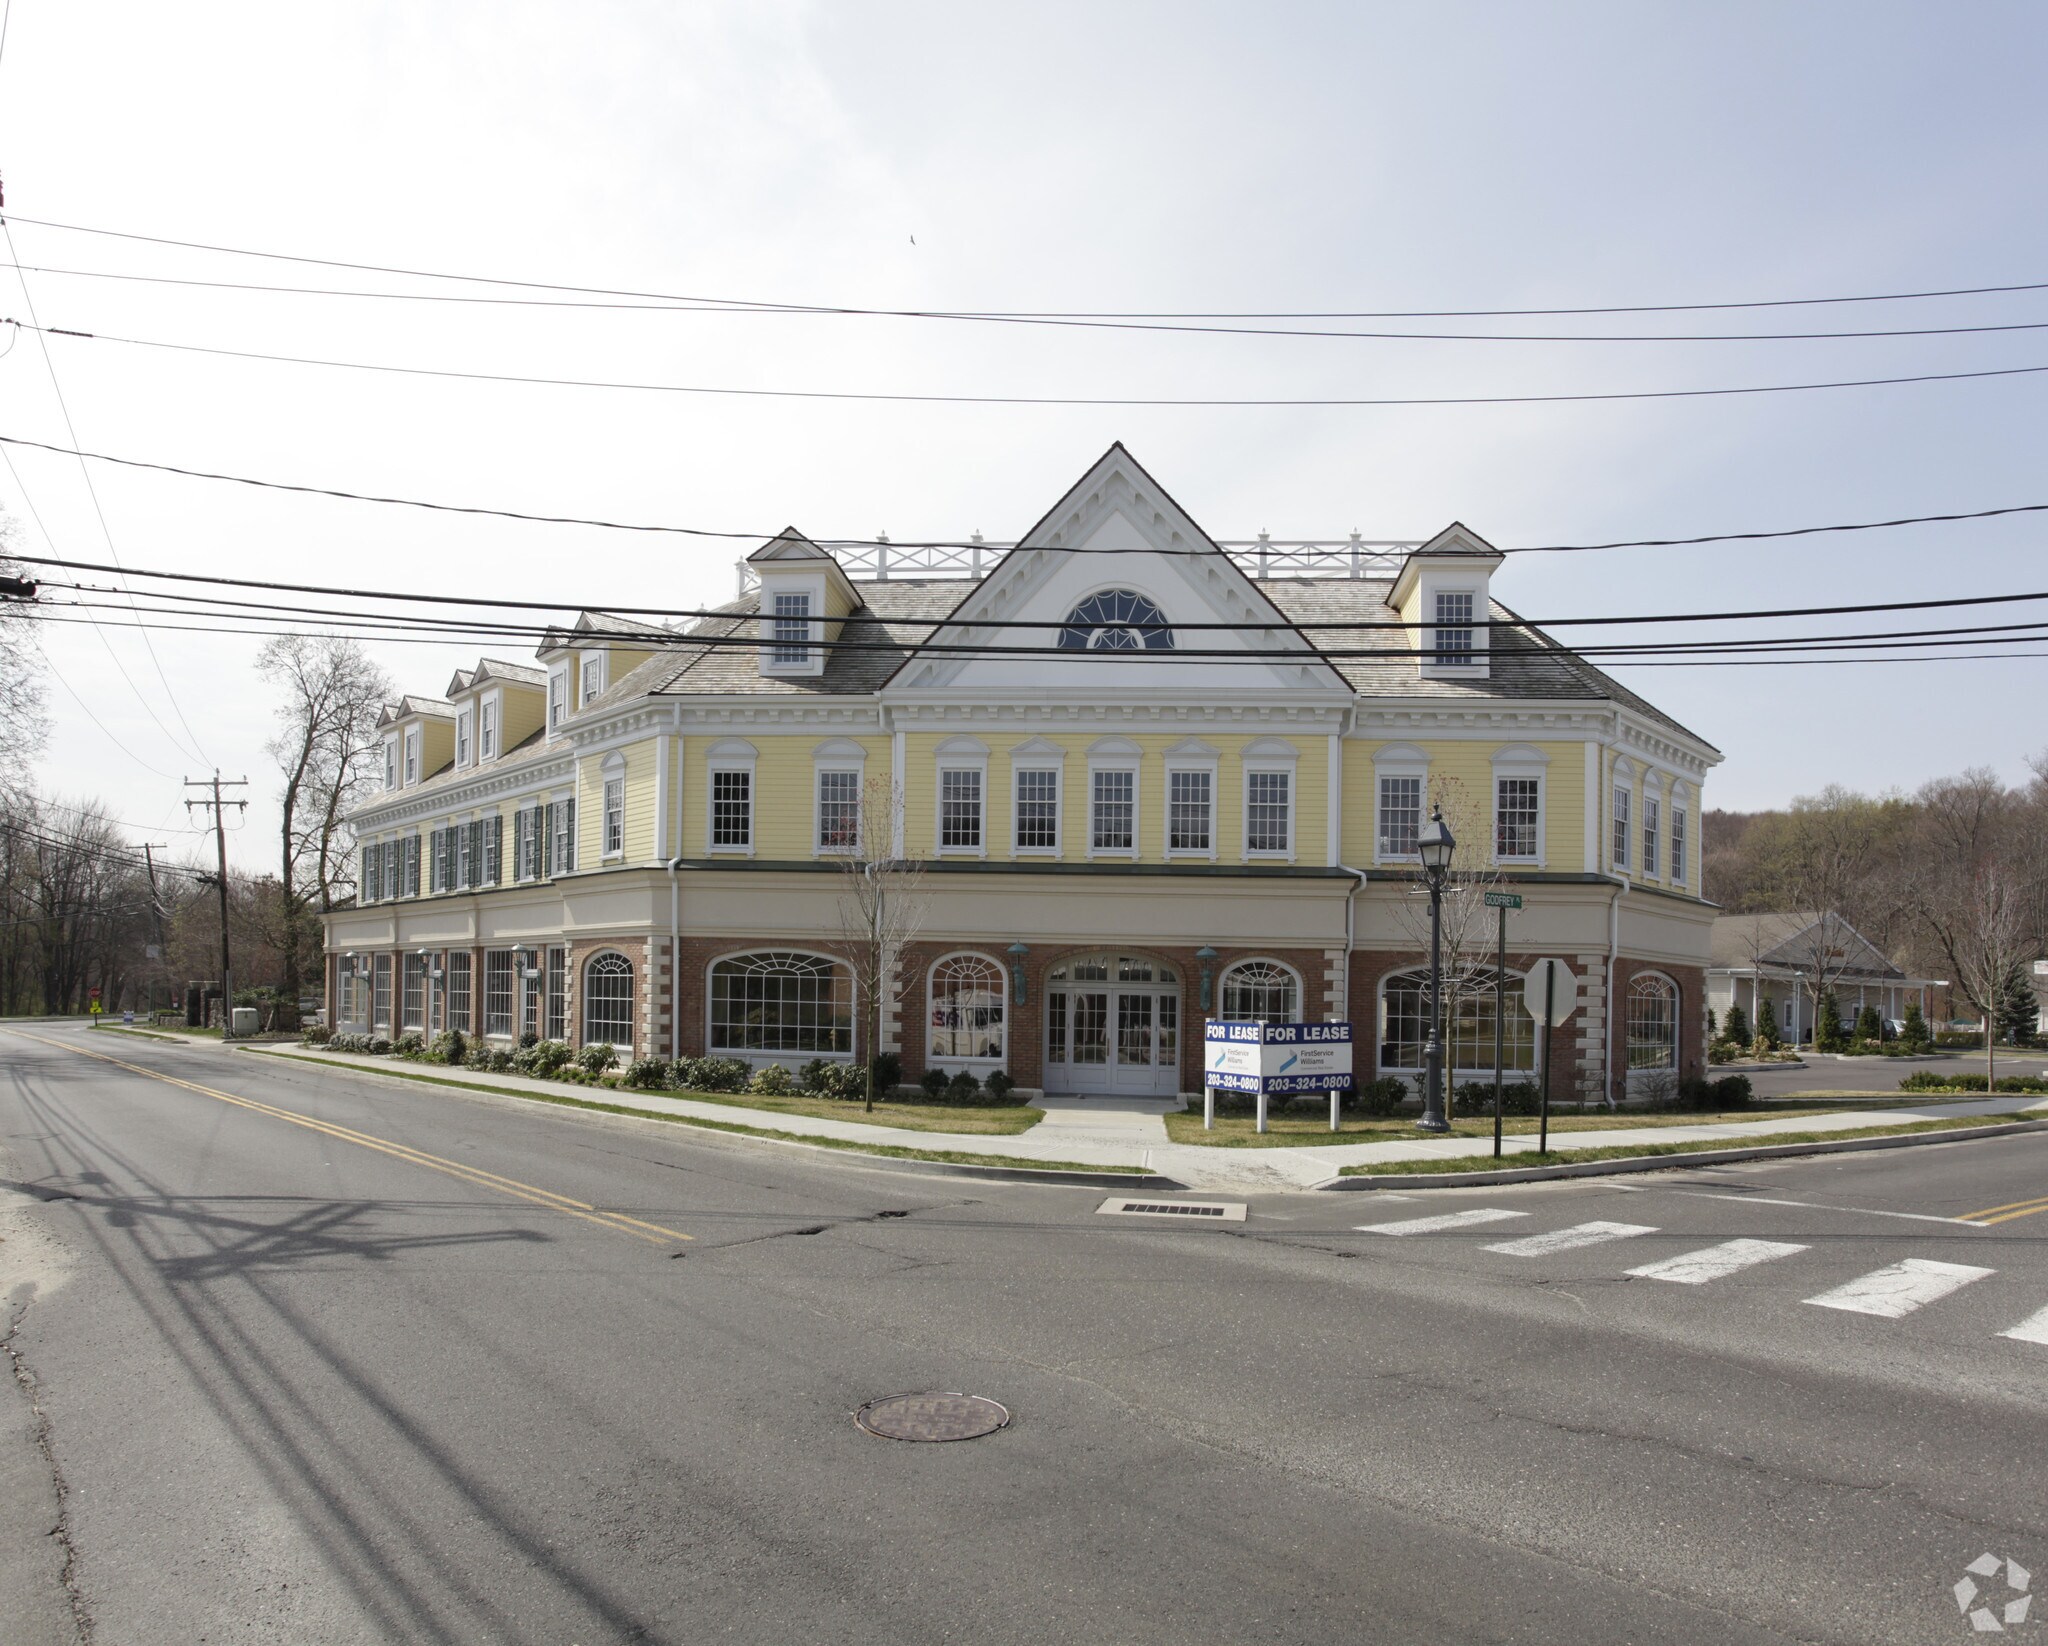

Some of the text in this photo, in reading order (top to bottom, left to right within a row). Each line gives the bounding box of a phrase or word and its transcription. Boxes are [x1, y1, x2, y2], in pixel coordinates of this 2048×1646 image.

[1485, 894, 1514, 906] GODFREY
[1207, 1025, 1259, 1040] FOR LEASE
[1266, 1026, 1349, 1041] FOR LEASE
[1300, 1049, 1334, 1057] FirstService
[1207, 1073, 1259, 1091] 203-324-0800
[1267, 1076, 1351, 1092] 203-324-0800
